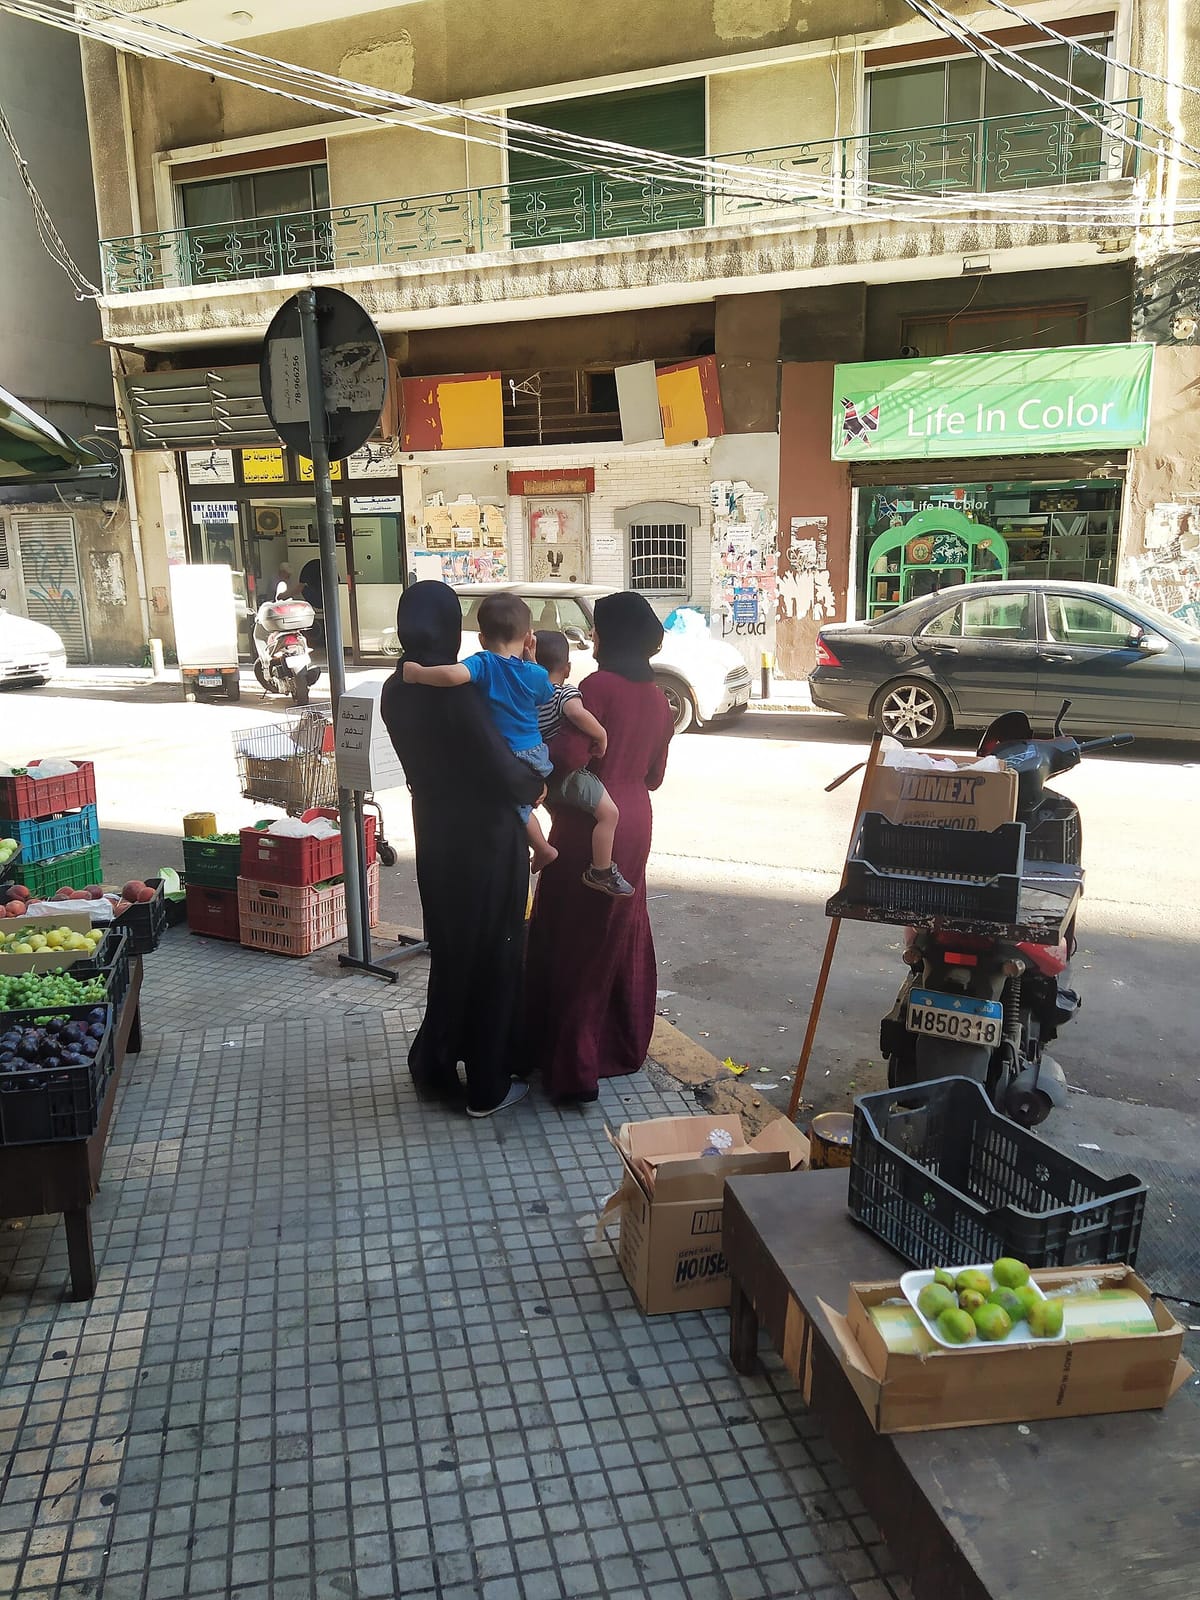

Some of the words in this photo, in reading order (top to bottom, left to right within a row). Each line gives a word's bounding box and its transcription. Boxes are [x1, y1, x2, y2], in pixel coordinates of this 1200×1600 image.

[292, 355, 302, 404] 78-966256
[907, 407, 966, 437] Life
[976, 403, 1006, 433] In
[1018, 396, 1114, 430] Color
[912, 500, 934, 512] Life
[938, 501, 950, 510] In
[954, 500, 989, 510] Color
[903, 775, 975, 804] DIMEX
[910, 1008, 996, 1043] M850318
